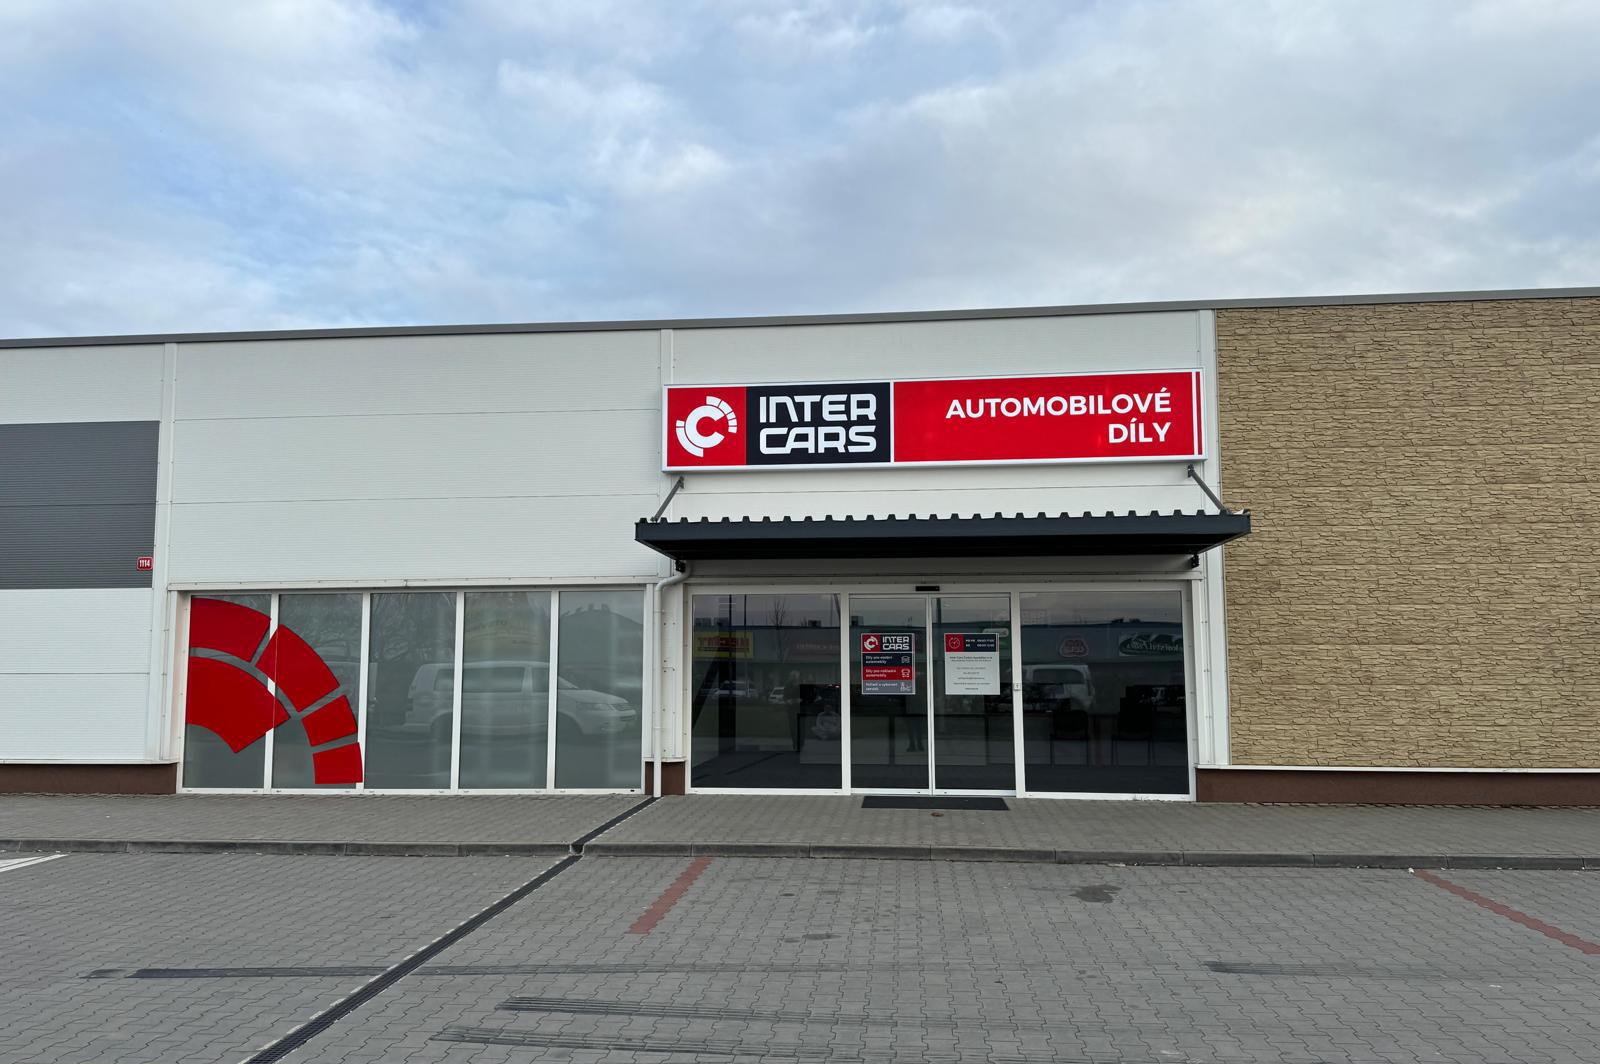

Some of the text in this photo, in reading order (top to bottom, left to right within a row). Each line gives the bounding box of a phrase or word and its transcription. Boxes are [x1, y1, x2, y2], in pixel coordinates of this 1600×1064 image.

[759, 393, 877, 423] INTER
[945, 387, 1172, 419] AUTOMOBILOVÉ
[759, 425, 877, 455] CARS
[1108, 417, 1172, 444] DÍLY
